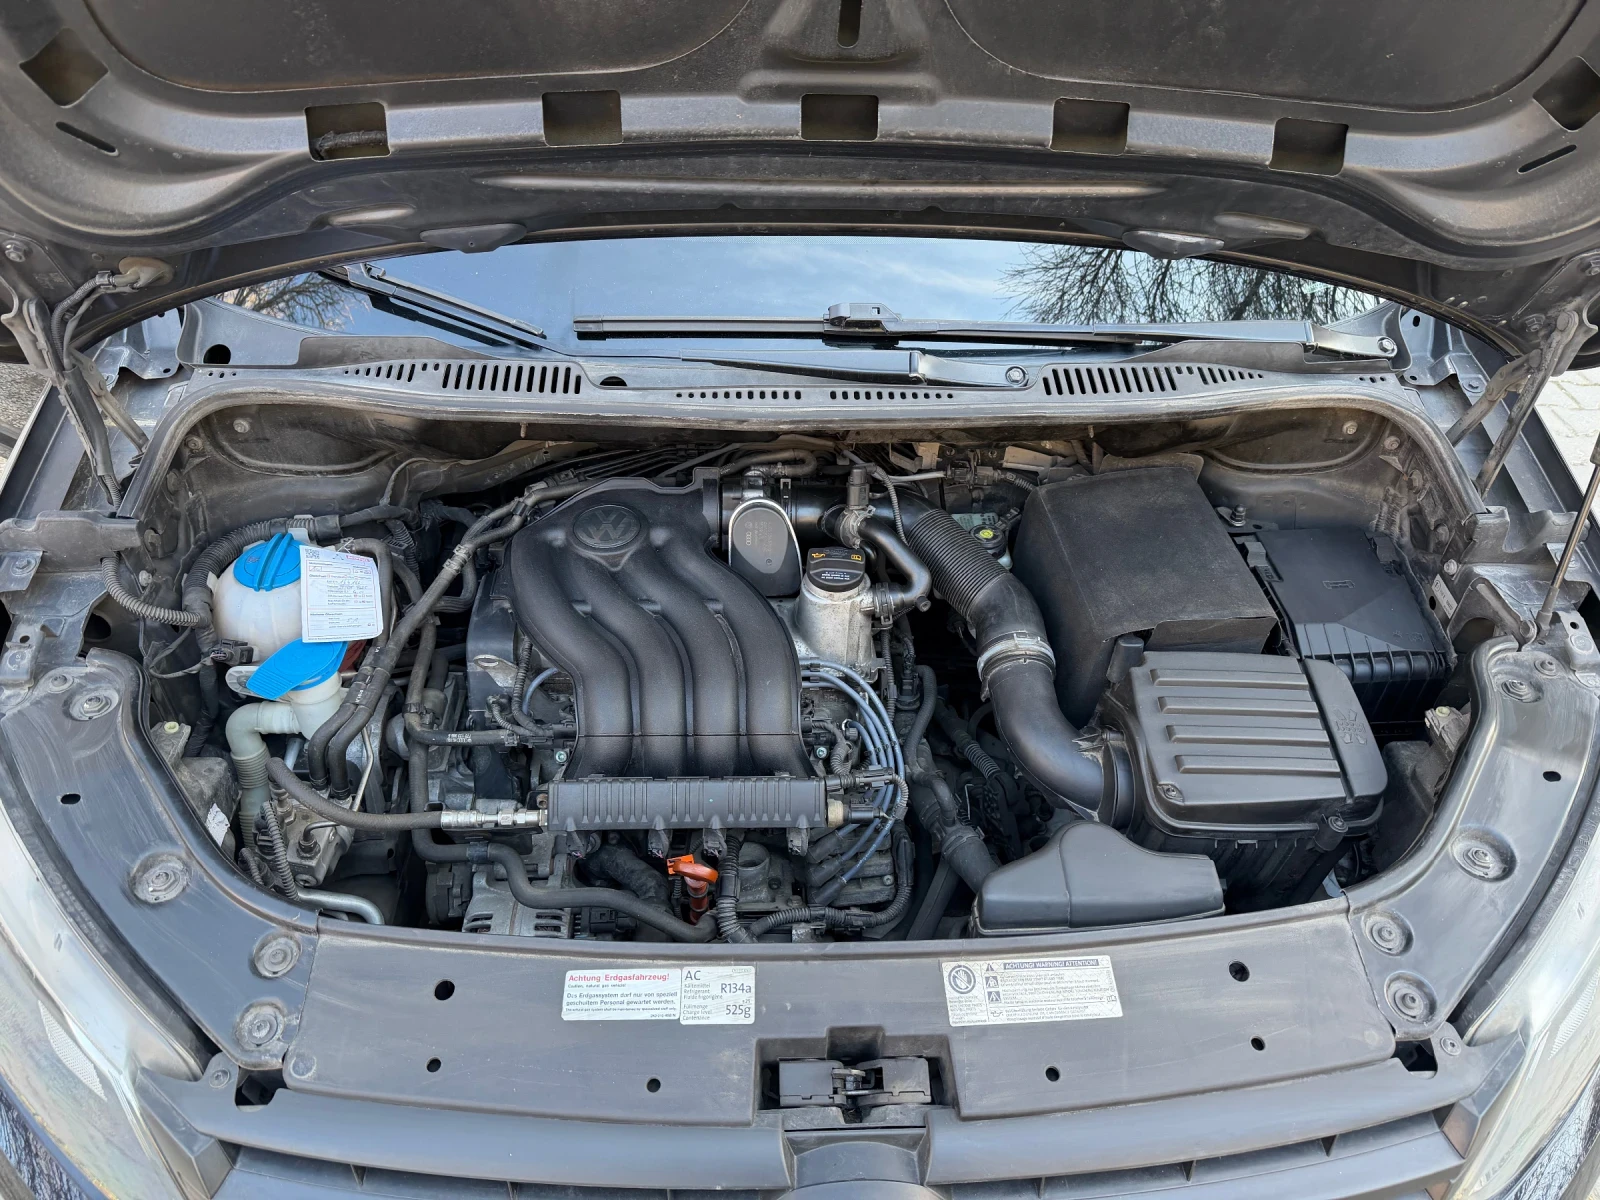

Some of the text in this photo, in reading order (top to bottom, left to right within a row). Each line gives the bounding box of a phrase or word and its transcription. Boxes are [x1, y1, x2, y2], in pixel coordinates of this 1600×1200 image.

[574, 505, 640, 548] VW
[604, 973, 670, 982] Erdgasfahrzeug!
[684, 970, 701, 980] AC
[721, 983, 751, 993] R134a
[726, 1004, 751, 1018] 525g
